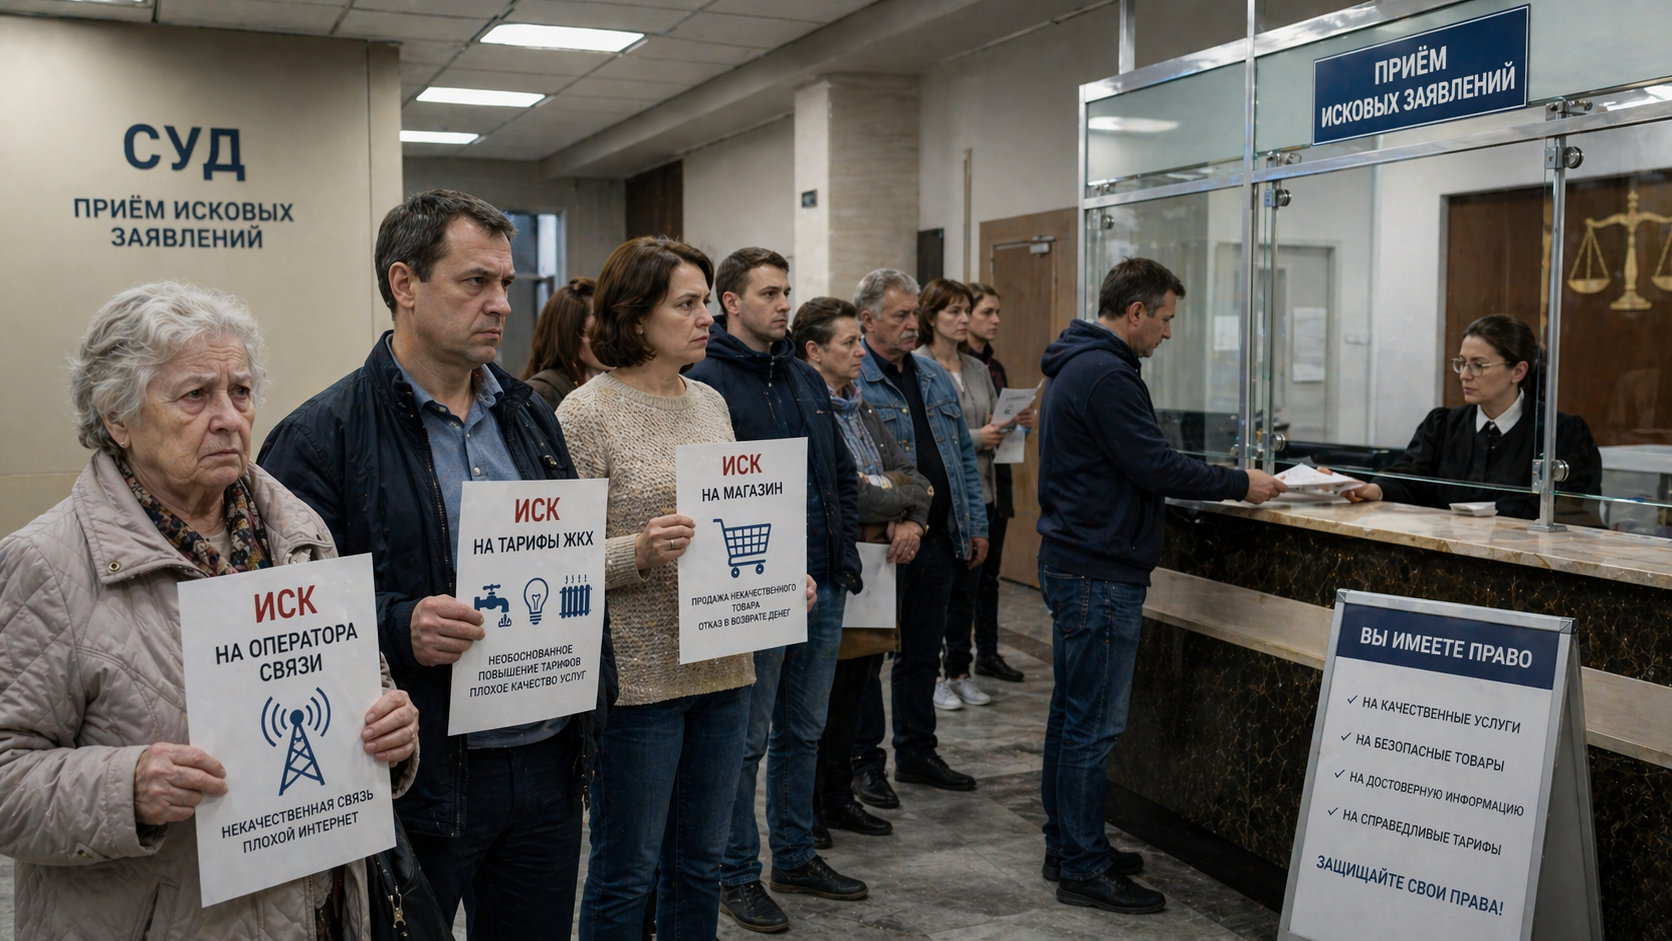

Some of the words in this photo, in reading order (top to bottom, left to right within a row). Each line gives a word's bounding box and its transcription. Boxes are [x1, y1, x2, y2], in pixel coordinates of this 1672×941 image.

[1375, 46, 1446, 85] ПРИЁМ
[1322, 92, 1399, 128] ИСКОВЫХ
[1403, 61, 1516, 111] ЗАЯВЛЕНИЙ
[124, 123, 246, 182] СУД
[74, 195, 165, 220] ПРИЁМ
[174, 201, 294, 222] ИСКОВЫХ
[111, 226, 263, 248] ЗАЯВЛЕНИЙ
[722, 453, 762, 476] ИСК
[702, 488, 720, 502] НА
[724, 482, 783, 500] МАГАЗИН
[514, 497, 560, 523] ИСК
[474, 538, 494, 555] НА
[498, 533, 559, 553] ТАРИФЫ
[564, 531, 594, 548] ЖКХ
[254, 585, 318, 624] ИСК
[692, 593, 729, 606] ПРОДАЖА
[730, 583, 796, 600] НЕКАЧЕСТВЕННОГО
[732, 602, 760, 612] ТОВАРА
[698, 620, 722, 630] ОТКАЗ
[724, 619, 730, 627] В
[731, 614, 767, 626] ВОЗВРАТЕ
[768, 608, 791, 621] ДЕНЕГ
[216, 643, 244, 665] НА
[249, 622, 358, 658] ОПЕРАТОРА
[488, 645, 573, 666] НЕОБОСНОВАННОЕ
[1360, 626, 1388, 647] ВЫ
[1392, 632, 1465, 659] ИМЕЕТЕ
[1468, 643, 1532, 668] ПРАВО
[260, 654, 322, 682] СВЯЗИ
[470, 683, 508, 697] ПЛОХОЕ
[511, 676, 558, 692] КАЧЕСТВО
[560, 670, 587, 684] УСЛУГ
[478, 663, 538, 681] ПОВЫШЕНИЕ
[541, 657, 581, 672] ТАРИФОВ
[1362, 697, 1378, 710] НА
[1380, 700, 1471, 725] КАЧЕСТВЕННЫЕ
[1474, 715, 1521, 734] УСЛУГИ
[1356, 734, 1371, 747] НА
[1374, 737, 1451, 763] БЕЗОПАСНЫЕ
[1455, 752, 1505, 772] ТОВАРЫ
[1350, 772, 1364, 784] НА
[1366, 775, 1443, 800] ДОСТОВЕРНУЮ
[1445, 792, 1524, 817] ИНФОРМАЦИЮ
[222, 798, 334, 838] НЕКАЧЕСТВЕННАЯ
[337, 789, 374, 808] СВЯЗЬ
[243, 826, 295, 854] ПЛОХОЙ
[298, 811, 358, 838] ИНТЕРНЕТ
[1342, 809, 1358, 822] НА
[1361, 813, 1450, 844] СПРАВЕДЛИВЫЕ
[1453, 834, 1502, 856] ТАРИФЫ
[1316, 855, 1405, 890] ЗАЩИЩАЙТЕ
[1407, 878, 1446, 901] СВОИ
[1450, 888, 1503, 916] ПРАВА!
